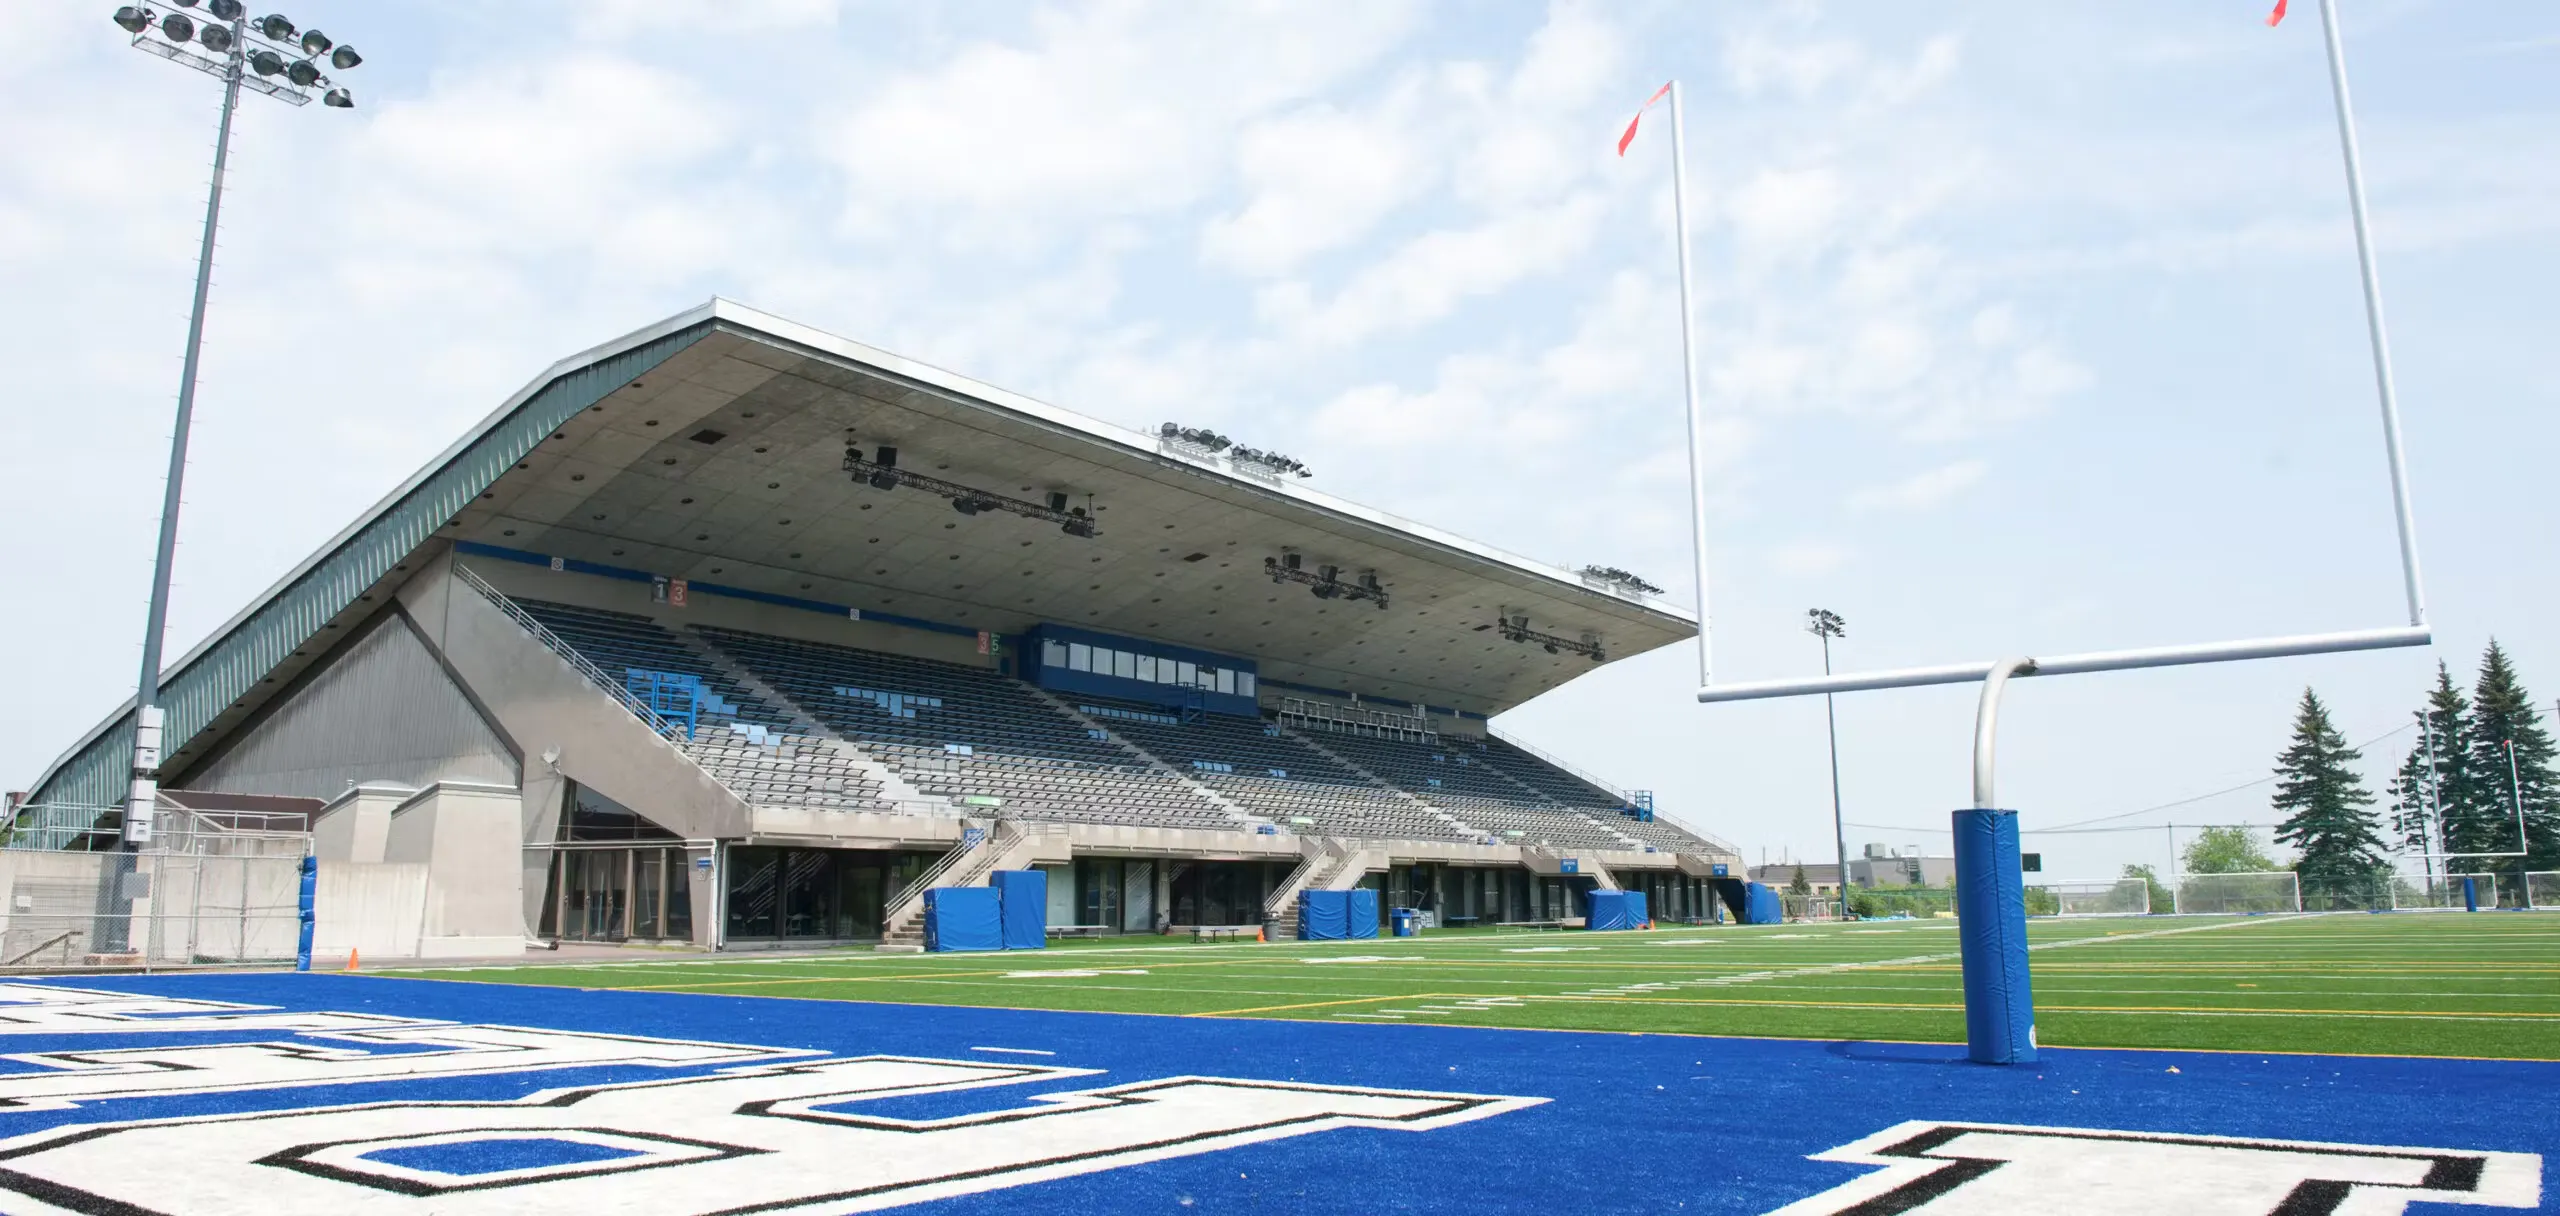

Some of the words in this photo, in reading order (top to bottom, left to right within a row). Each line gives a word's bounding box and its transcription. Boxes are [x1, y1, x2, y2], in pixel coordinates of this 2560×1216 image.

[657, 583, 664, 598] 1
[675, 586, 683, 601] 3
[992, 639, 999, 652] 5
